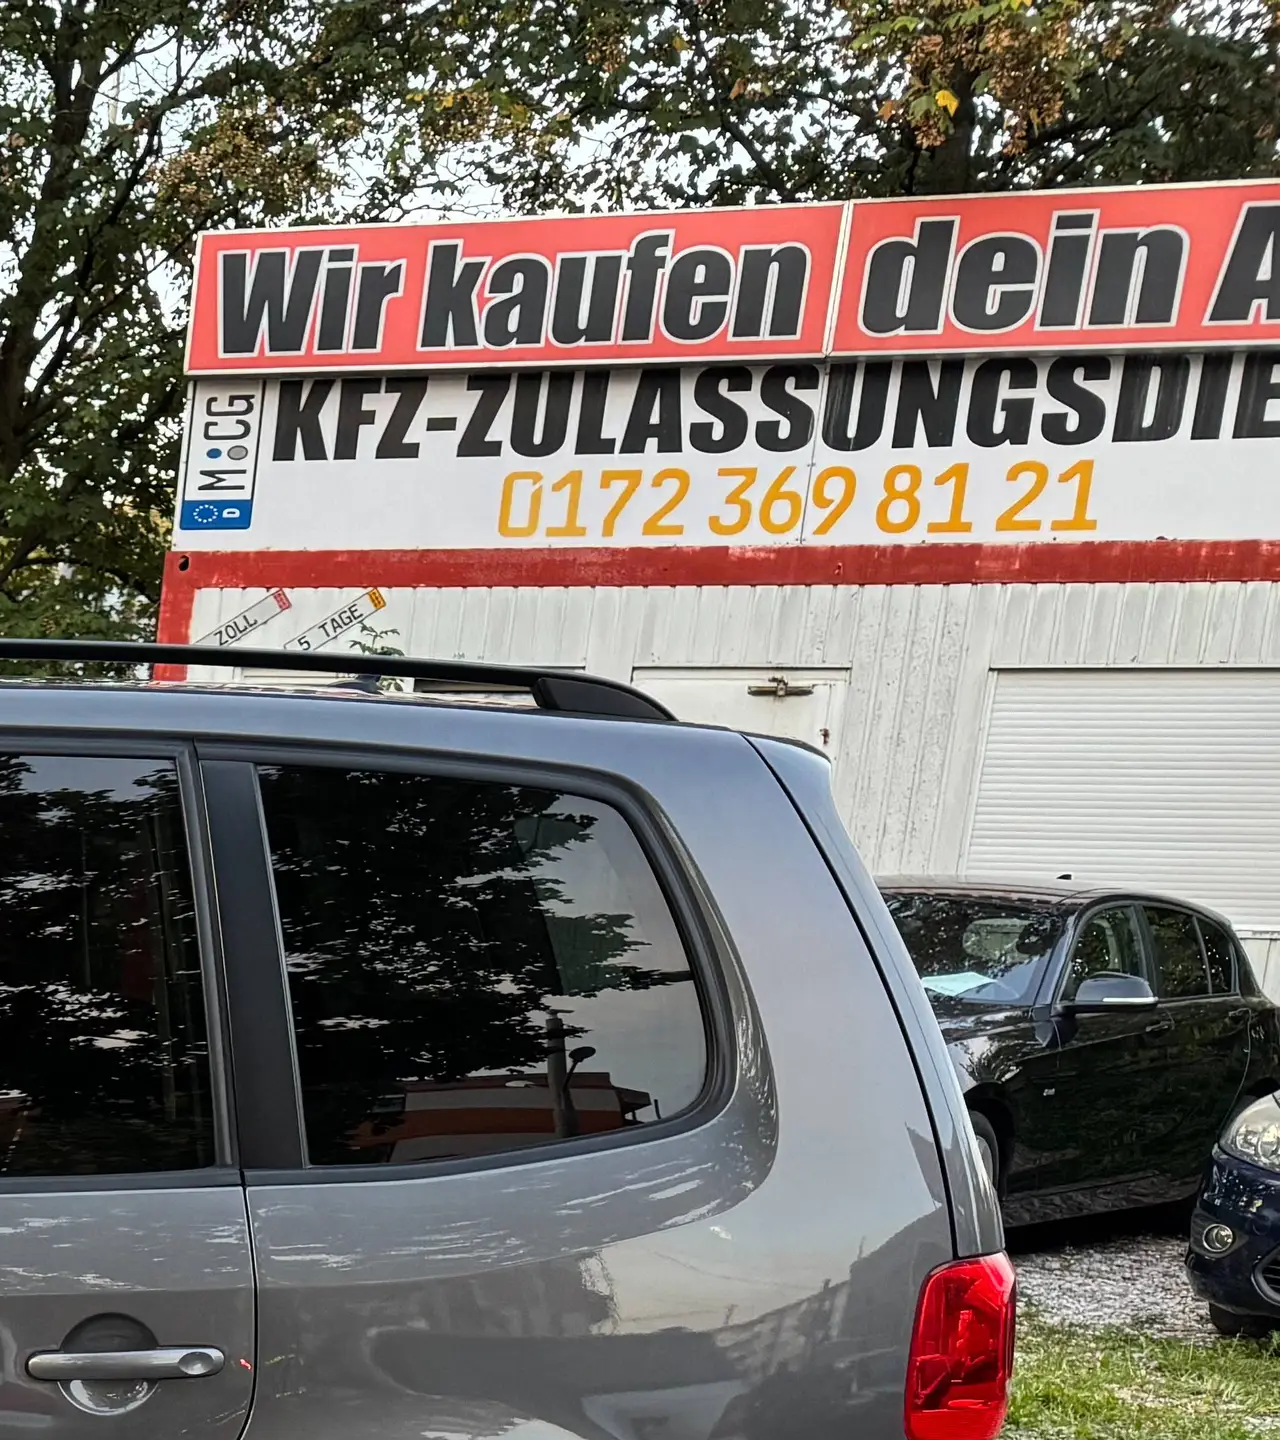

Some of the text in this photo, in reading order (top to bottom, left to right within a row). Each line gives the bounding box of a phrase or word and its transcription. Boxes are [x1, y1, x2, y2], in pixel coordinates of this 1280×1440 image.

[218, 245, 405, 357] Wir
[417, 230, 811, 350] kaufen
[859, 209, 1188, 335] dein
[497, 459, 1098, 540] 0172 369 81 21
[213, 613, 258, 646] ZOLL
[297, 602, 364, 651] 5 TAGE
